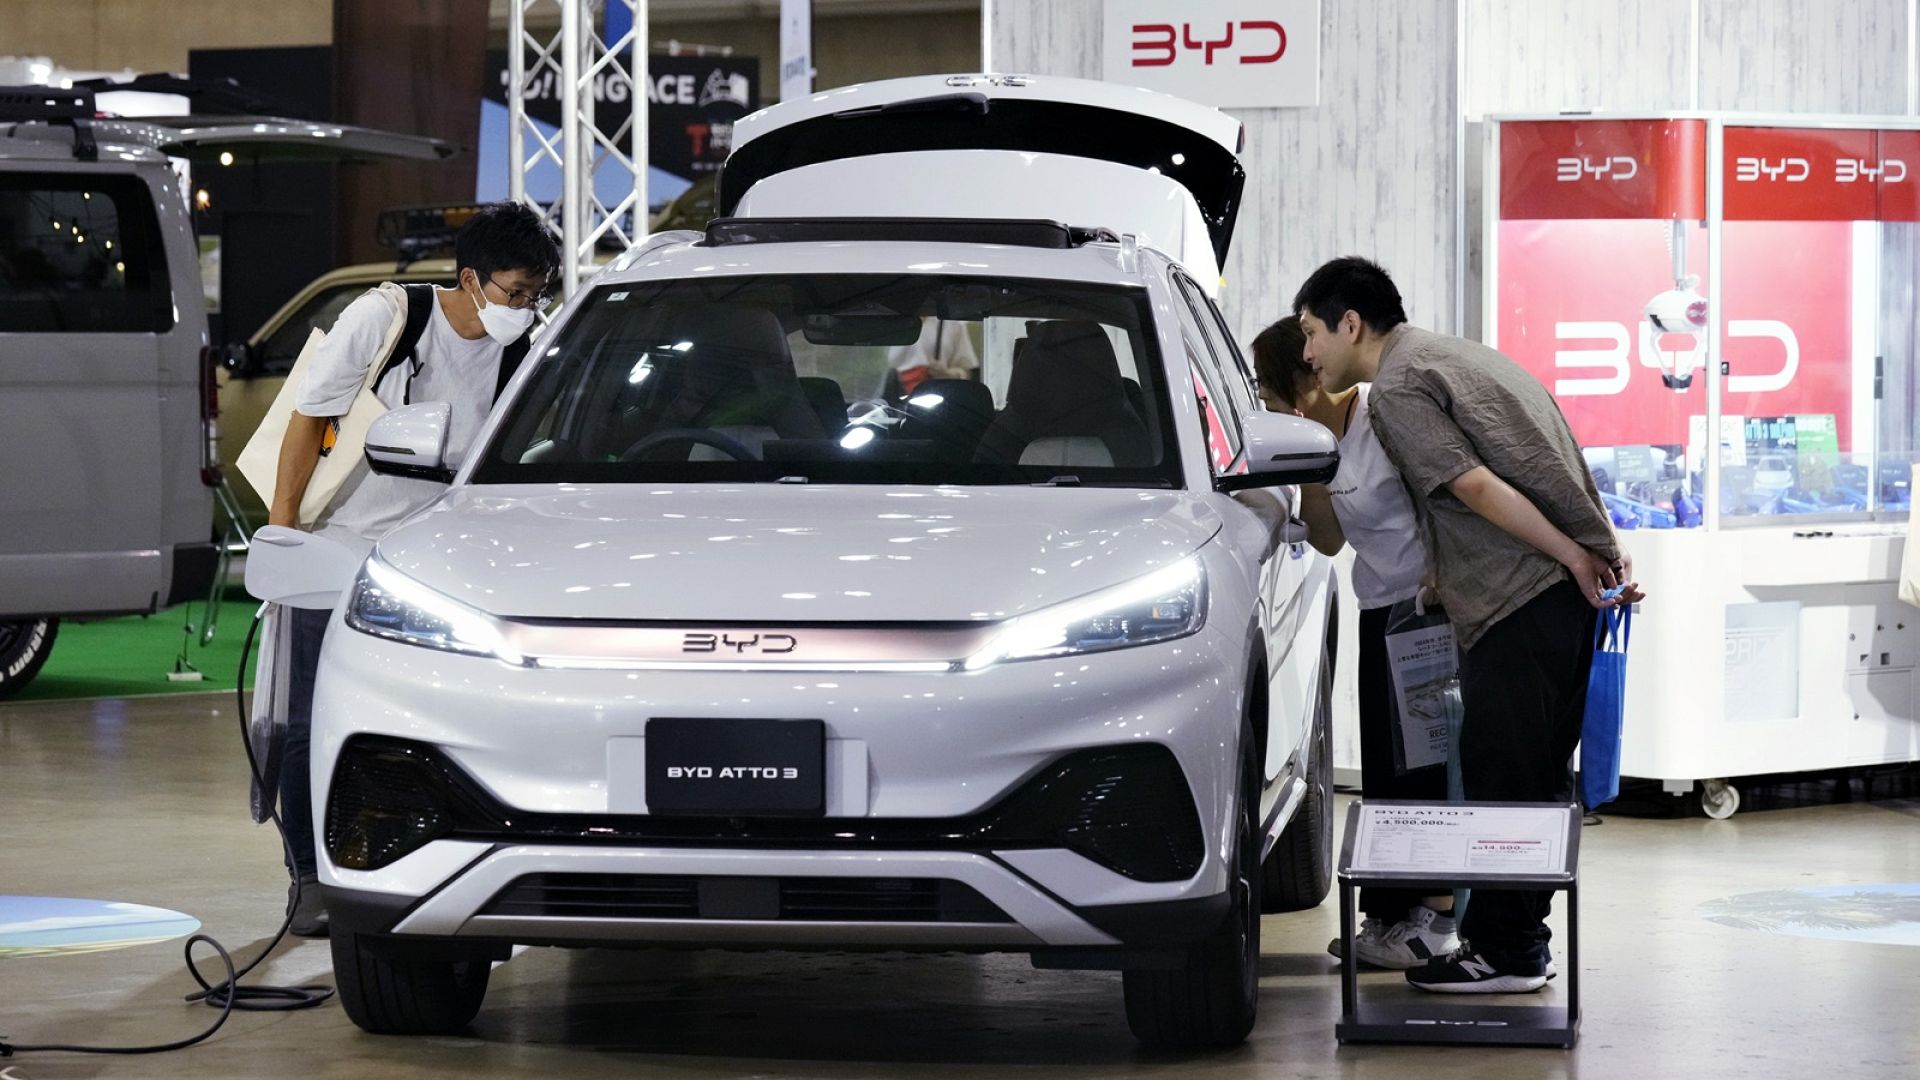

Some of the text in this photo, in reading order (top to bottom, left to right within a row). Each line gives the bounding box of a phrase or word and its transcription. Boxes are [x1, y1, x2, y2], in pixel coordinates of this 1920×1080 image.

[1132, 21, 1287, 67] BYD
[1557, 157, 1637, 181] BYD
[1736, 157, 1906, 182] BYD BYD
[682, 633, 797, 653] BYD
[667, 767, 798, 778] BYD ATTO 3
